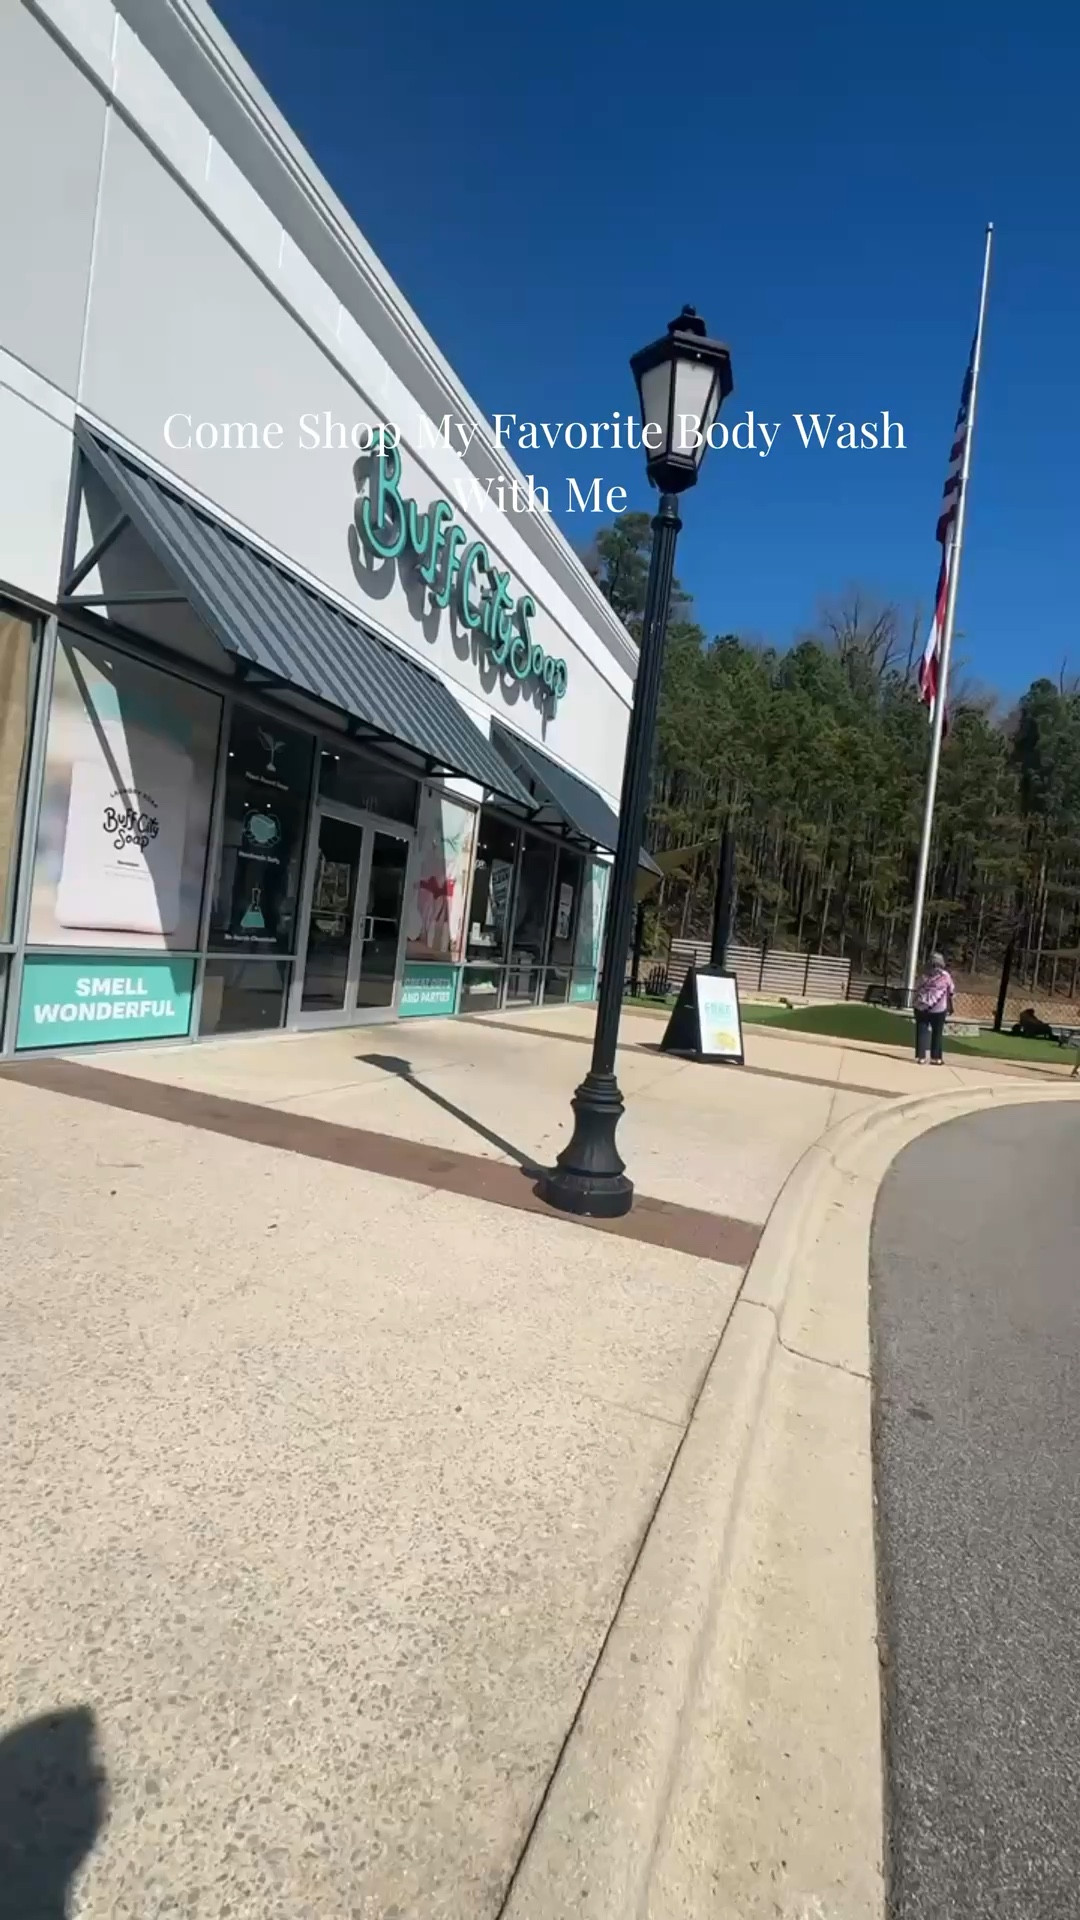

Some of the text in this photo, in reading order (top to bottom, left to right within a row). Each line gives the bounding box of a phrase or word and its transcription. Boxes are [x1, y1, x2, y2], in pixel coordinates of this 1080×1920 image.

[355, 426, 568, 717] Buff City Soap
[103, 807, 159, 839] Buff City
[113, 829, 150, 853] Soap
[75, 977, 148, 997] SMELL
[33, 1000, 175, 1024] WONDERFUL
